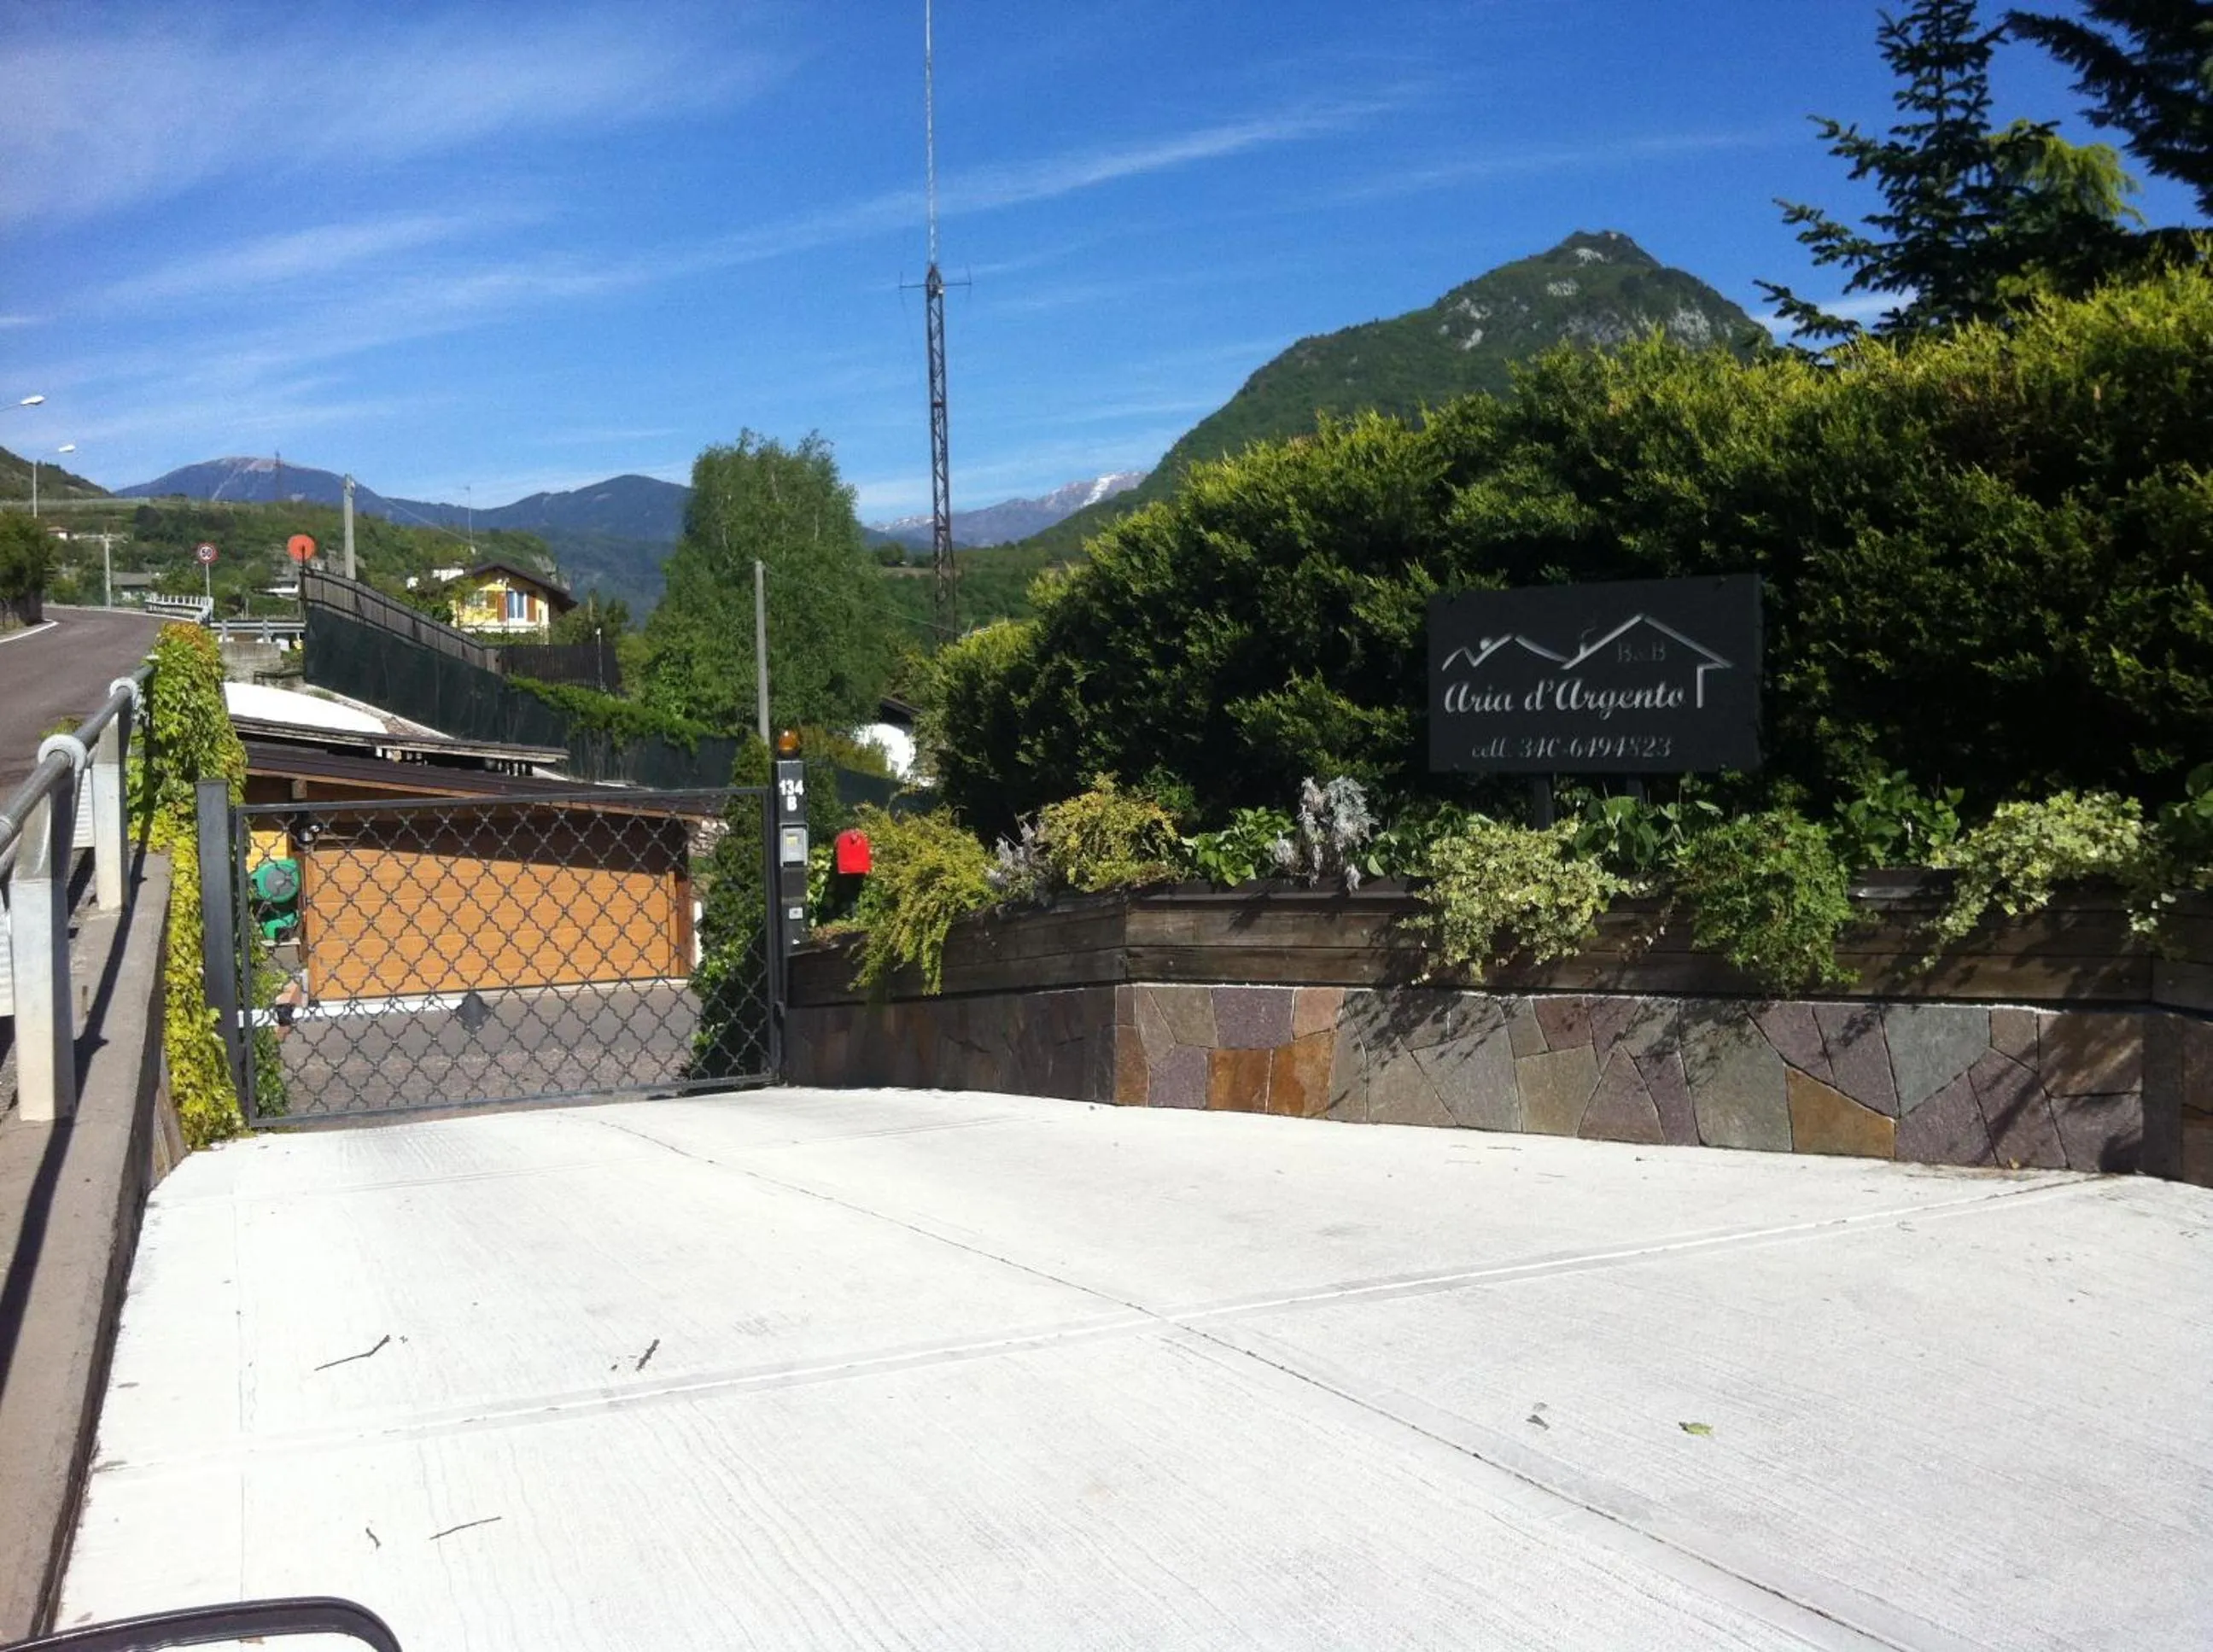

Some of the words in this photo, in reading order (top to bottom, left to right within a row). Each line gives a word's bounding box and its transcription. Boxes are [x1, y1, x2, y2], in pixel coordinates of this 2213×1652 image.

[1445, 682, 1514, 713] Aria
[1525, 680, 1685, 721] d'Argento
[779, 779, 804, 796] 134
[787, 796, 797, 811] B
